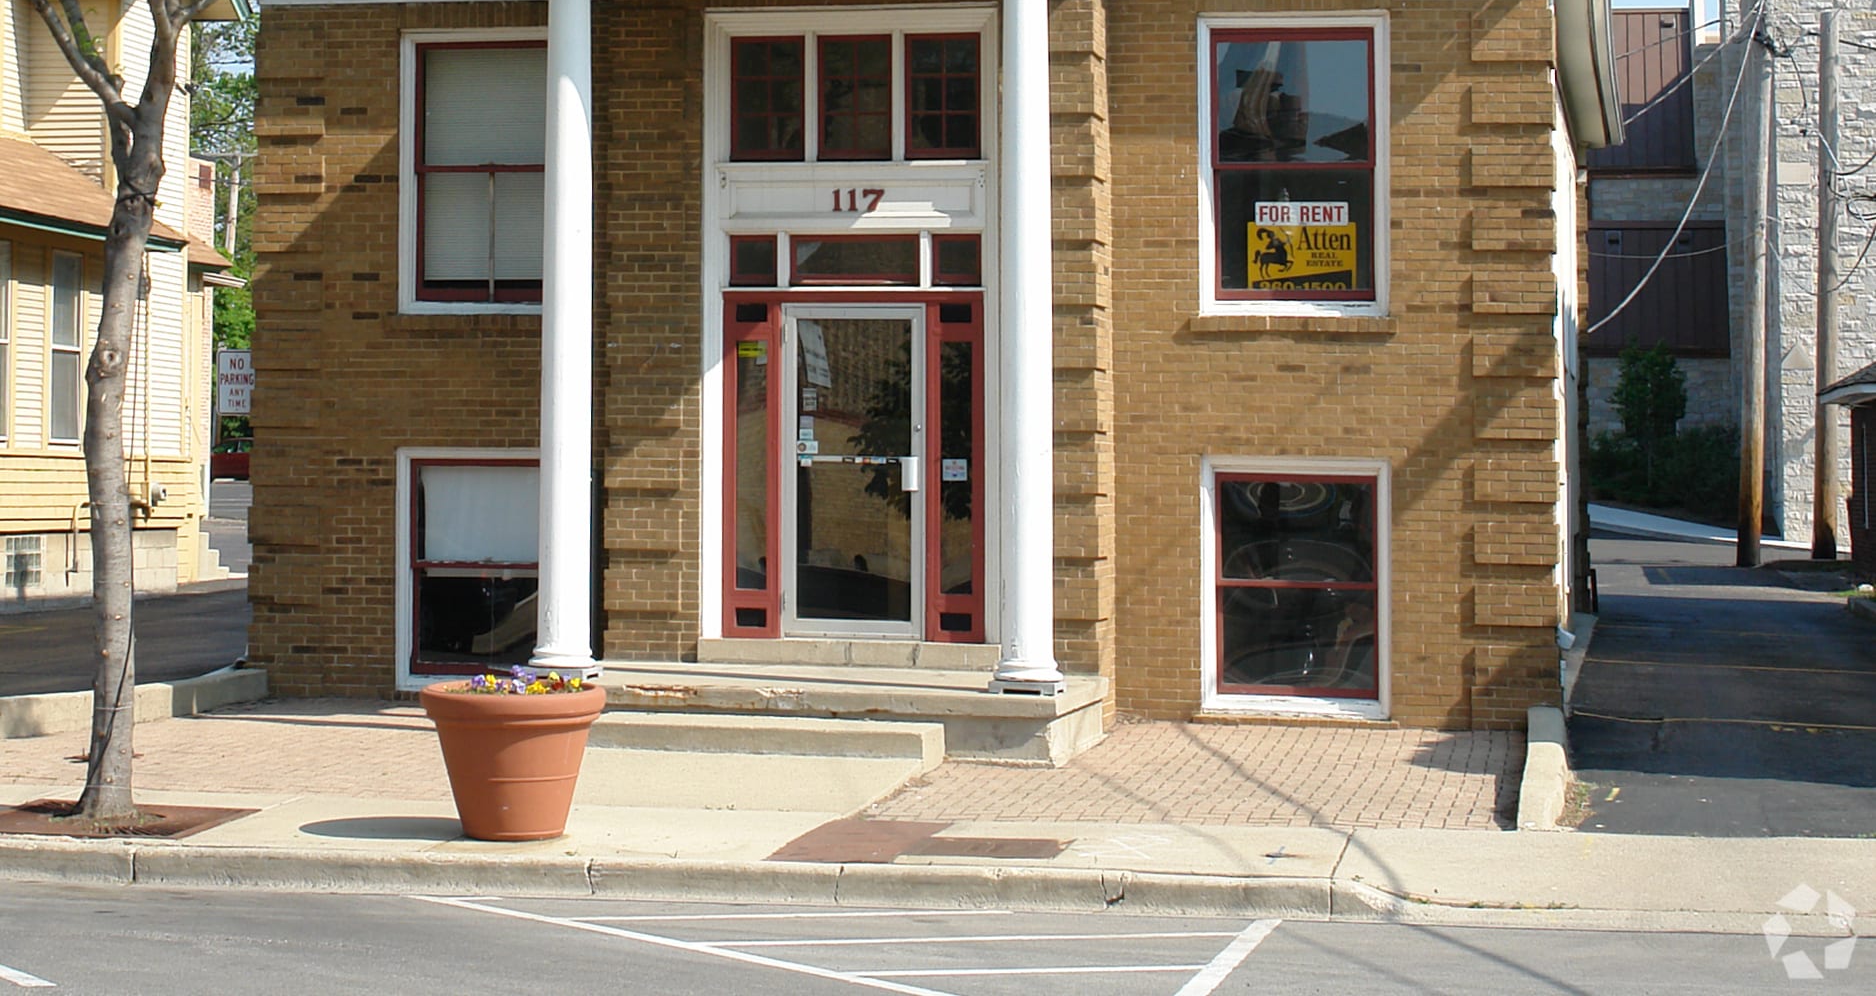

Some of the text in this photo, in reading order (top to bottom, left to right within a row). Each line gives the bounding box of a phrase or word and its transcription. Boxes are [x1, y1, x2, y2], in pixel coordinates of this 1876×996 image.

[832, 188, 885, 212] 117
[1259, 205, 1345, 223] FOR RENT
[1296, 226, 1352, 251] Atten
[1306, 260, 1344, 268] ESTATE
[229, 358, 245, 371] NO
[220, 373, 255, 386] PARKING
[229, 388, 245, 397] ANY
[227, 399, 246, 409] TIME
